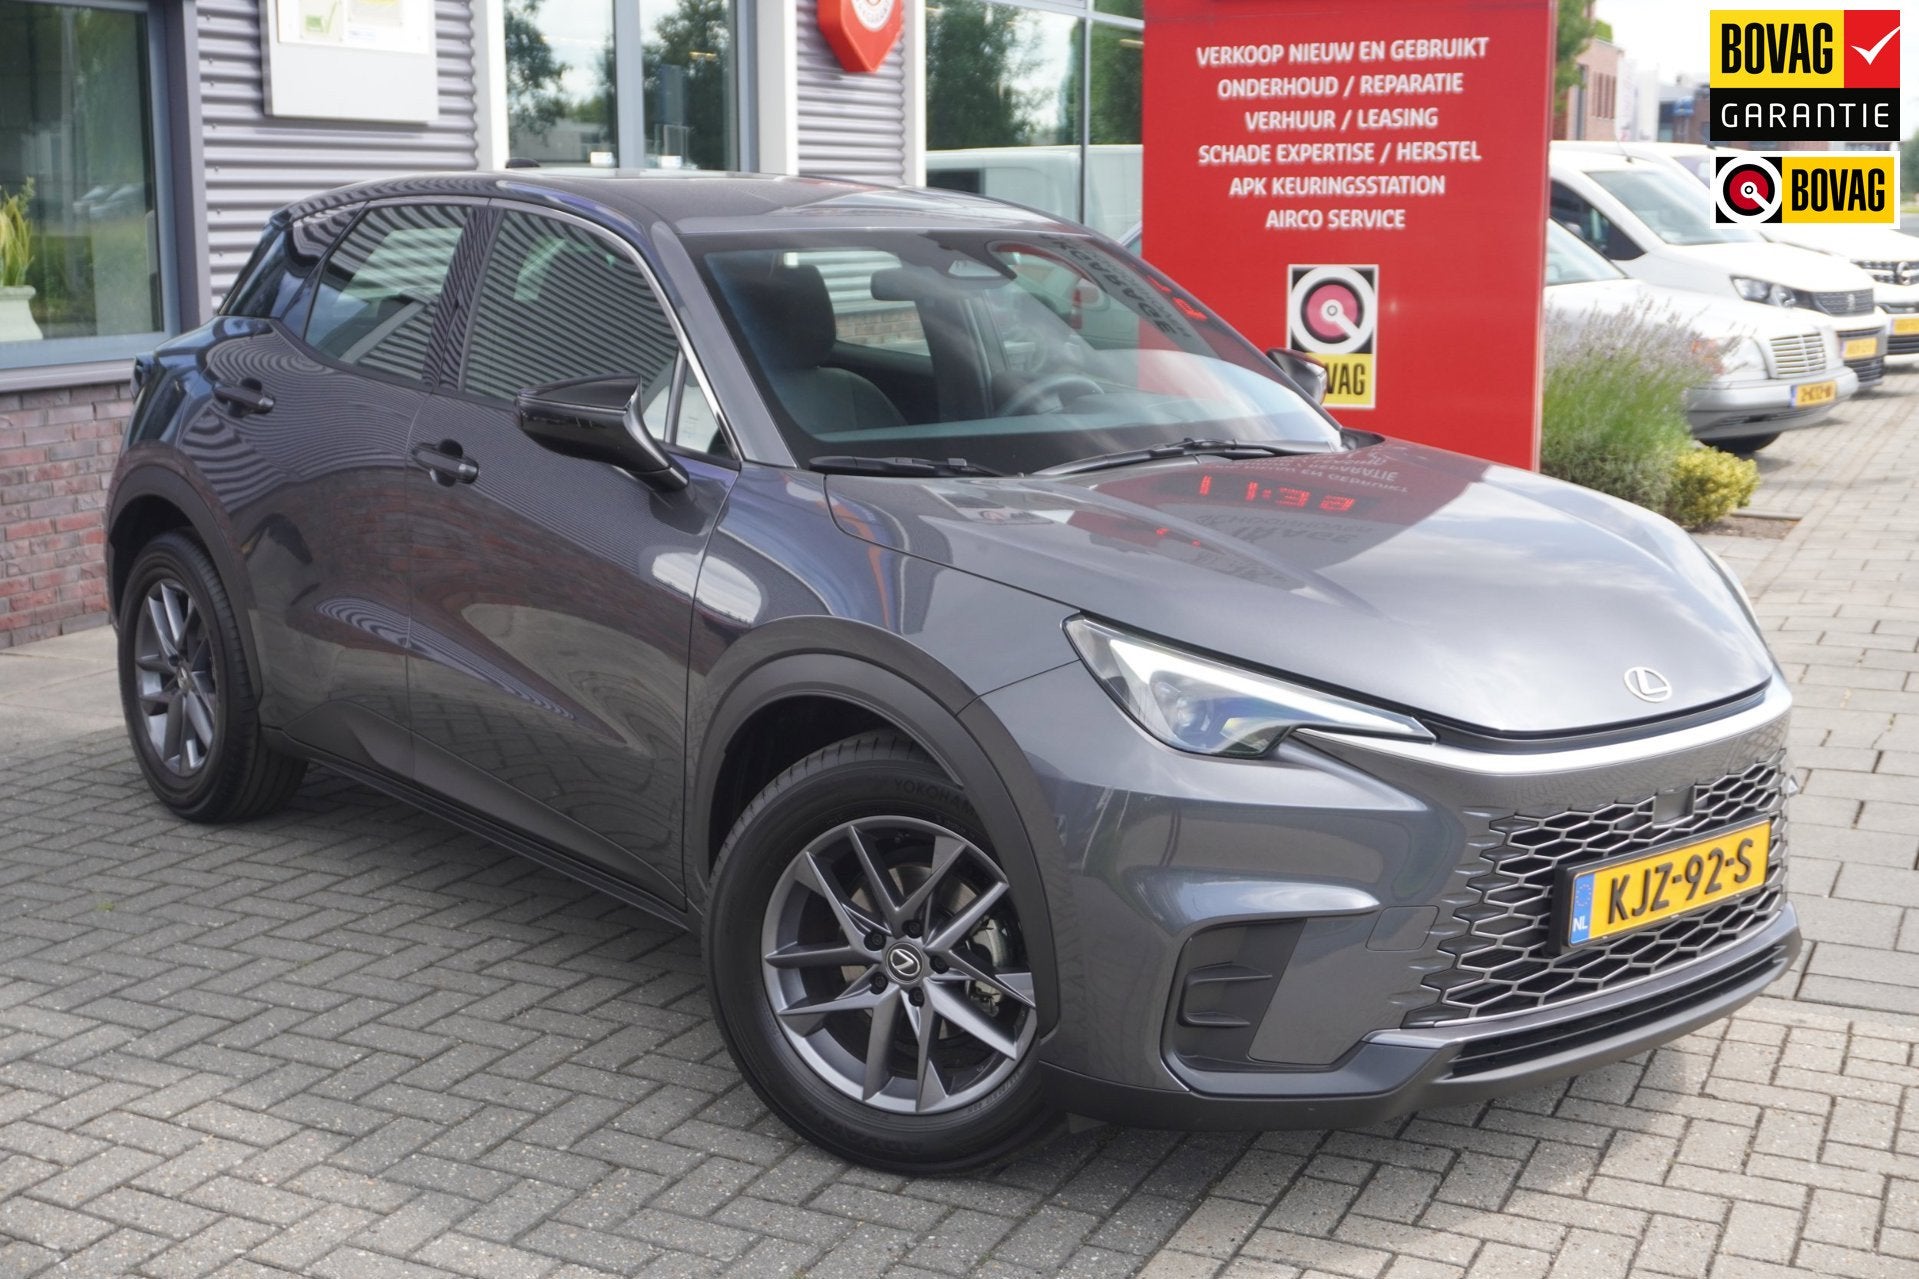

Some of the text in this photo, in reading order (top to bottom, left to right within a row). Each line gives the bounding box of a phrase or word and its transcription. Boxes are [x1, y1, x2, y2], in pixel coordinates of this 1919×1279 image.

[1197, 37, 1489, 66] VERKOOP NIEUW EN GEBRUIKT
[1218, 73, 1463, 98] ONDERHOUD / REPARATIE
[1245, 108, 1438, 131] VERHUUR / LEASING
[1199, 141, 1482, 164] SCHADE EXPERTISE / HERSTEL
[1229, 175, 1445, 196] APK KEURINGSSTATION
[1266, 209, 1405, 229] AIRCO SERVICE
[1324, 362, 1366, 396] VAG
[894, 777, 976, 816] YOKOHAM
[1572, 838, 1753, 932] NL KJZ-92-S
